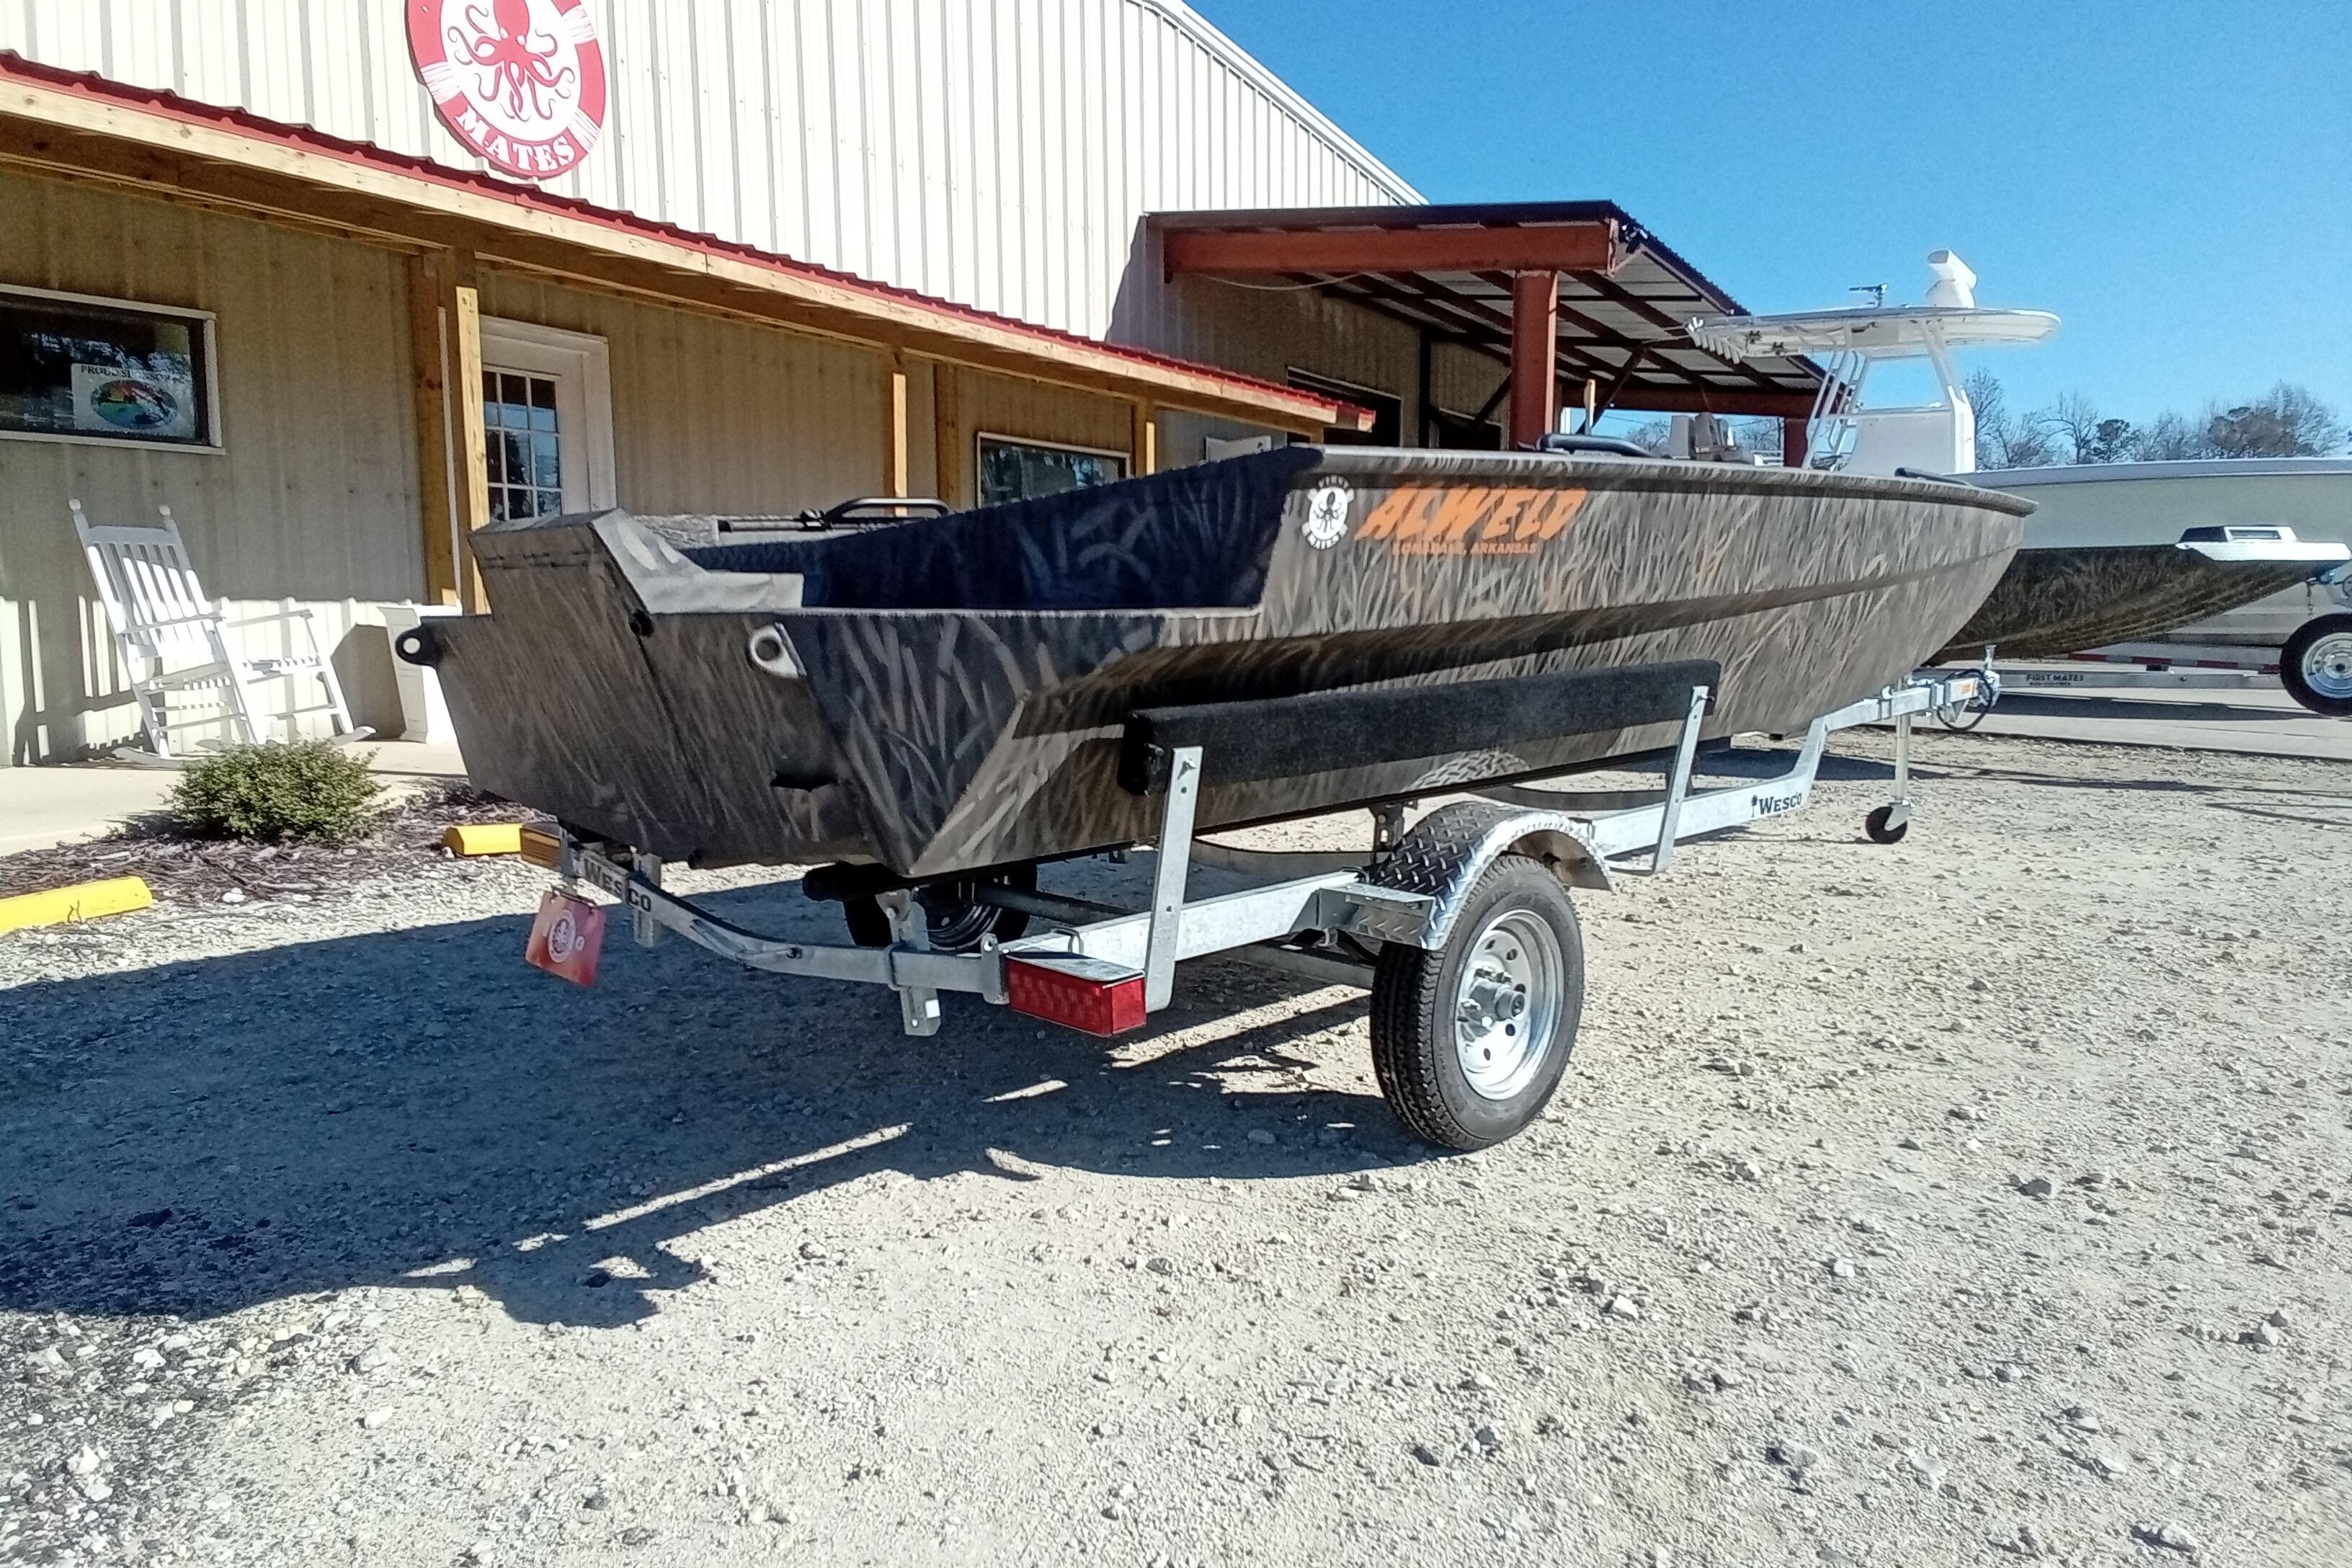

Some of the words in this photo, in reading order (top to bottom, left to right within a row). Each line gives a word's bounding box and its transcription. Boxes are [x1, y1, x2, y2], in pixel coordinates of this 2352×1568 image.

[455, 104, 575, 172] MATES
[1355, 481, 1587, 541] ALWELD
[1470, 543, 1538, 554] ARKANSAS
[1759, 792, 1802, 815] WESCO
